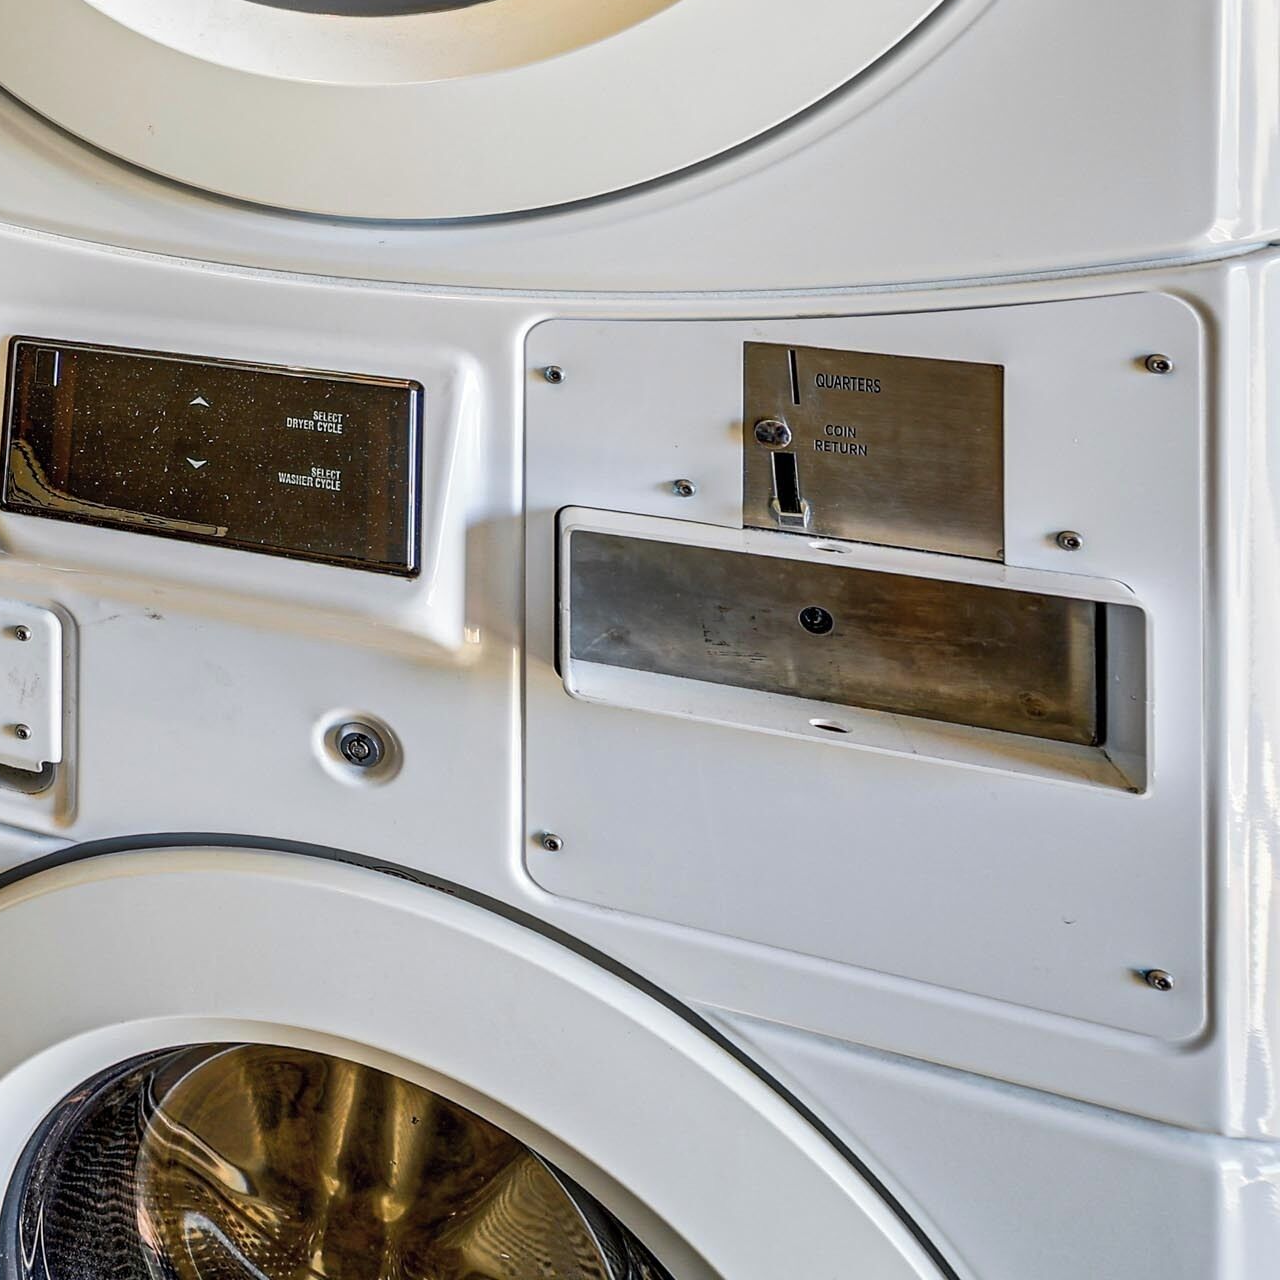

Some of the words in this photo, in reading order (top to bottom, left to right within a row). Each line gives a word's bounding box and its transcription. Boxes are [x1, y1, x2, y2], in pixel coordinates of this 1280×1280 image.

[816, 373, 881, 393] QUARTERS
[287, 417, 314, 431] DRYER
[318, 422, 343, 434] CYCLE
[313, 411, 343, 423] SELECT
[825, 425, 857, 439] COIN
[815, 440, 868, 457] RETURN
[279, 472, 313, 487] WASHER
[315, 478, 341, 491] CYCLE
[312, 467, 341, 480] SELECT
